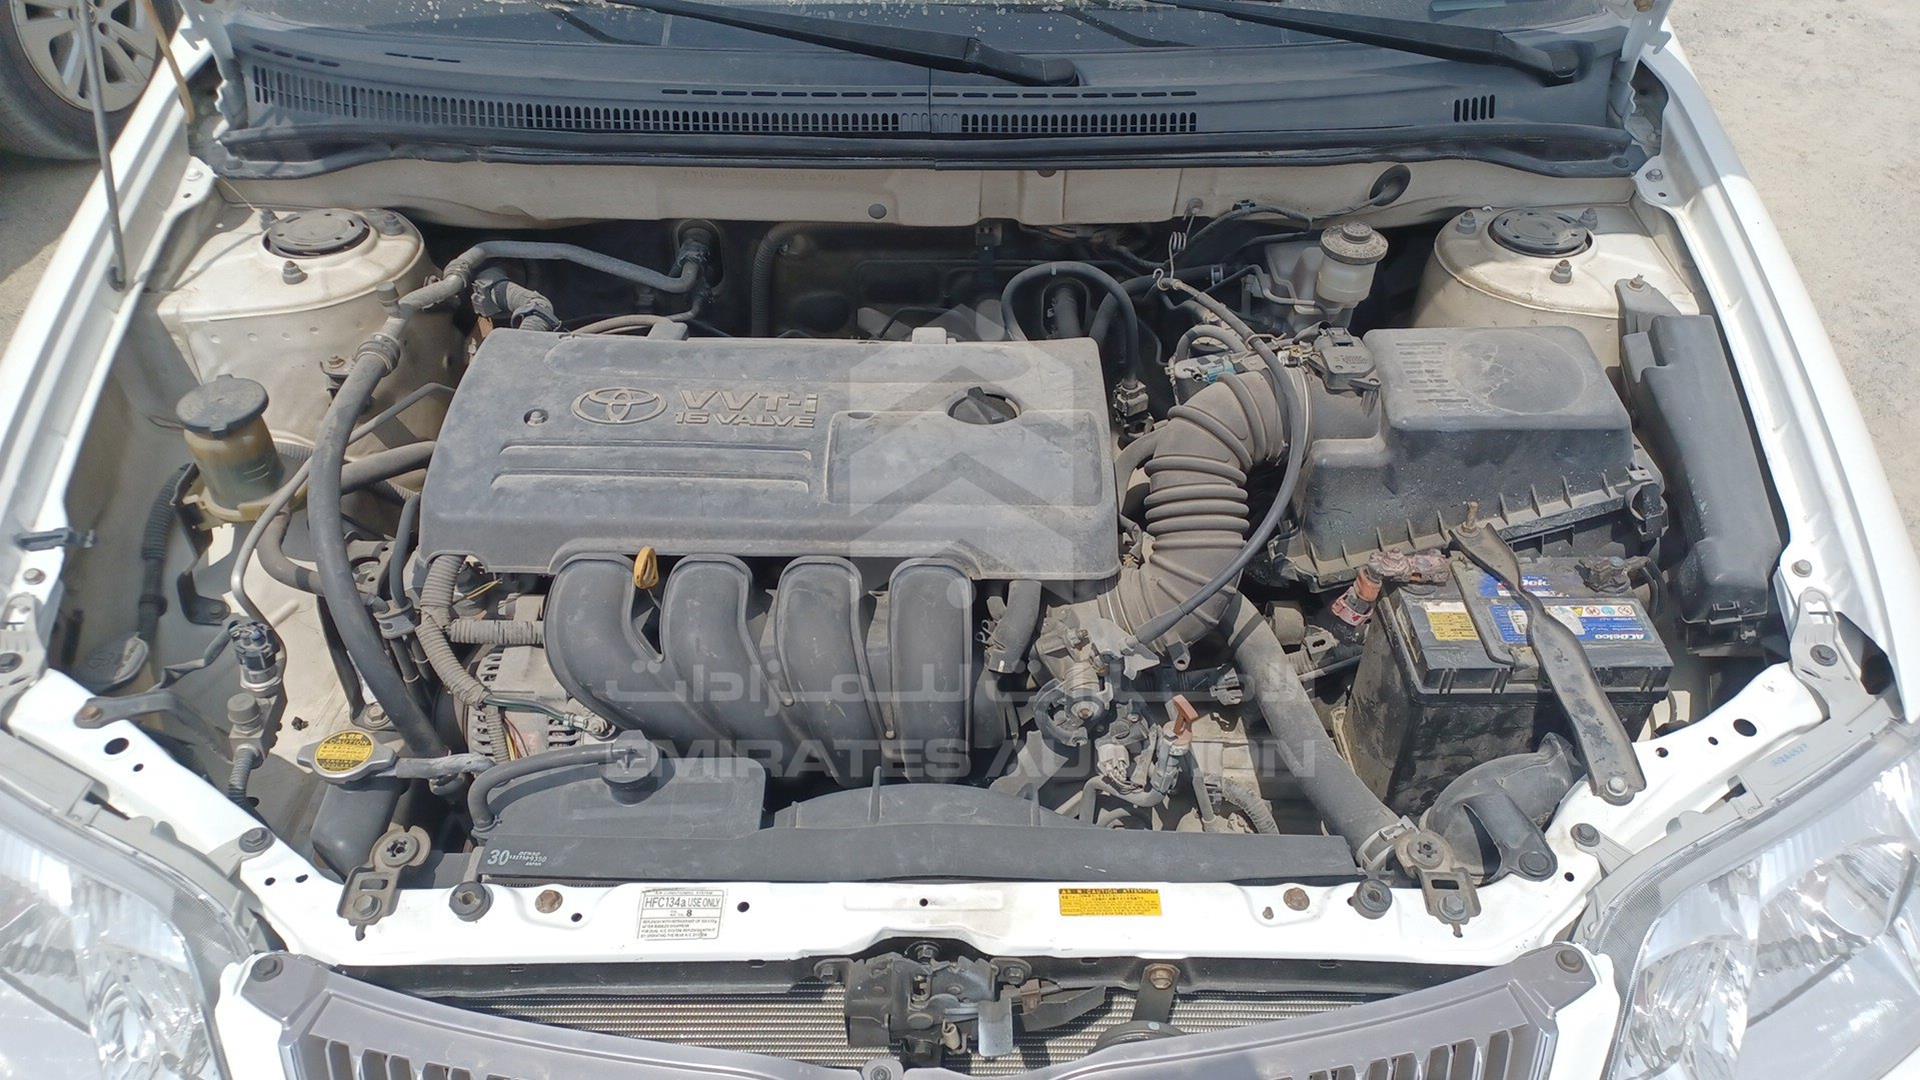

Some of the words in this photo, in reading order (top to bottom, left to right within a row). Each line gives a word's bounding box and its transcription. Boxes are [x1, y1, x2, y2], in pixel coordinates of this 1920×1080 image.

[680, 390, 819, 414] VVT-i
[713, 412, 816, 428] VALVE
[487, 849, 510, 866] 30
[645, 897, 686, 908] HFC134a
[687, 897, 701, 908] USE
[702, 897, 721, 908] ONLY
